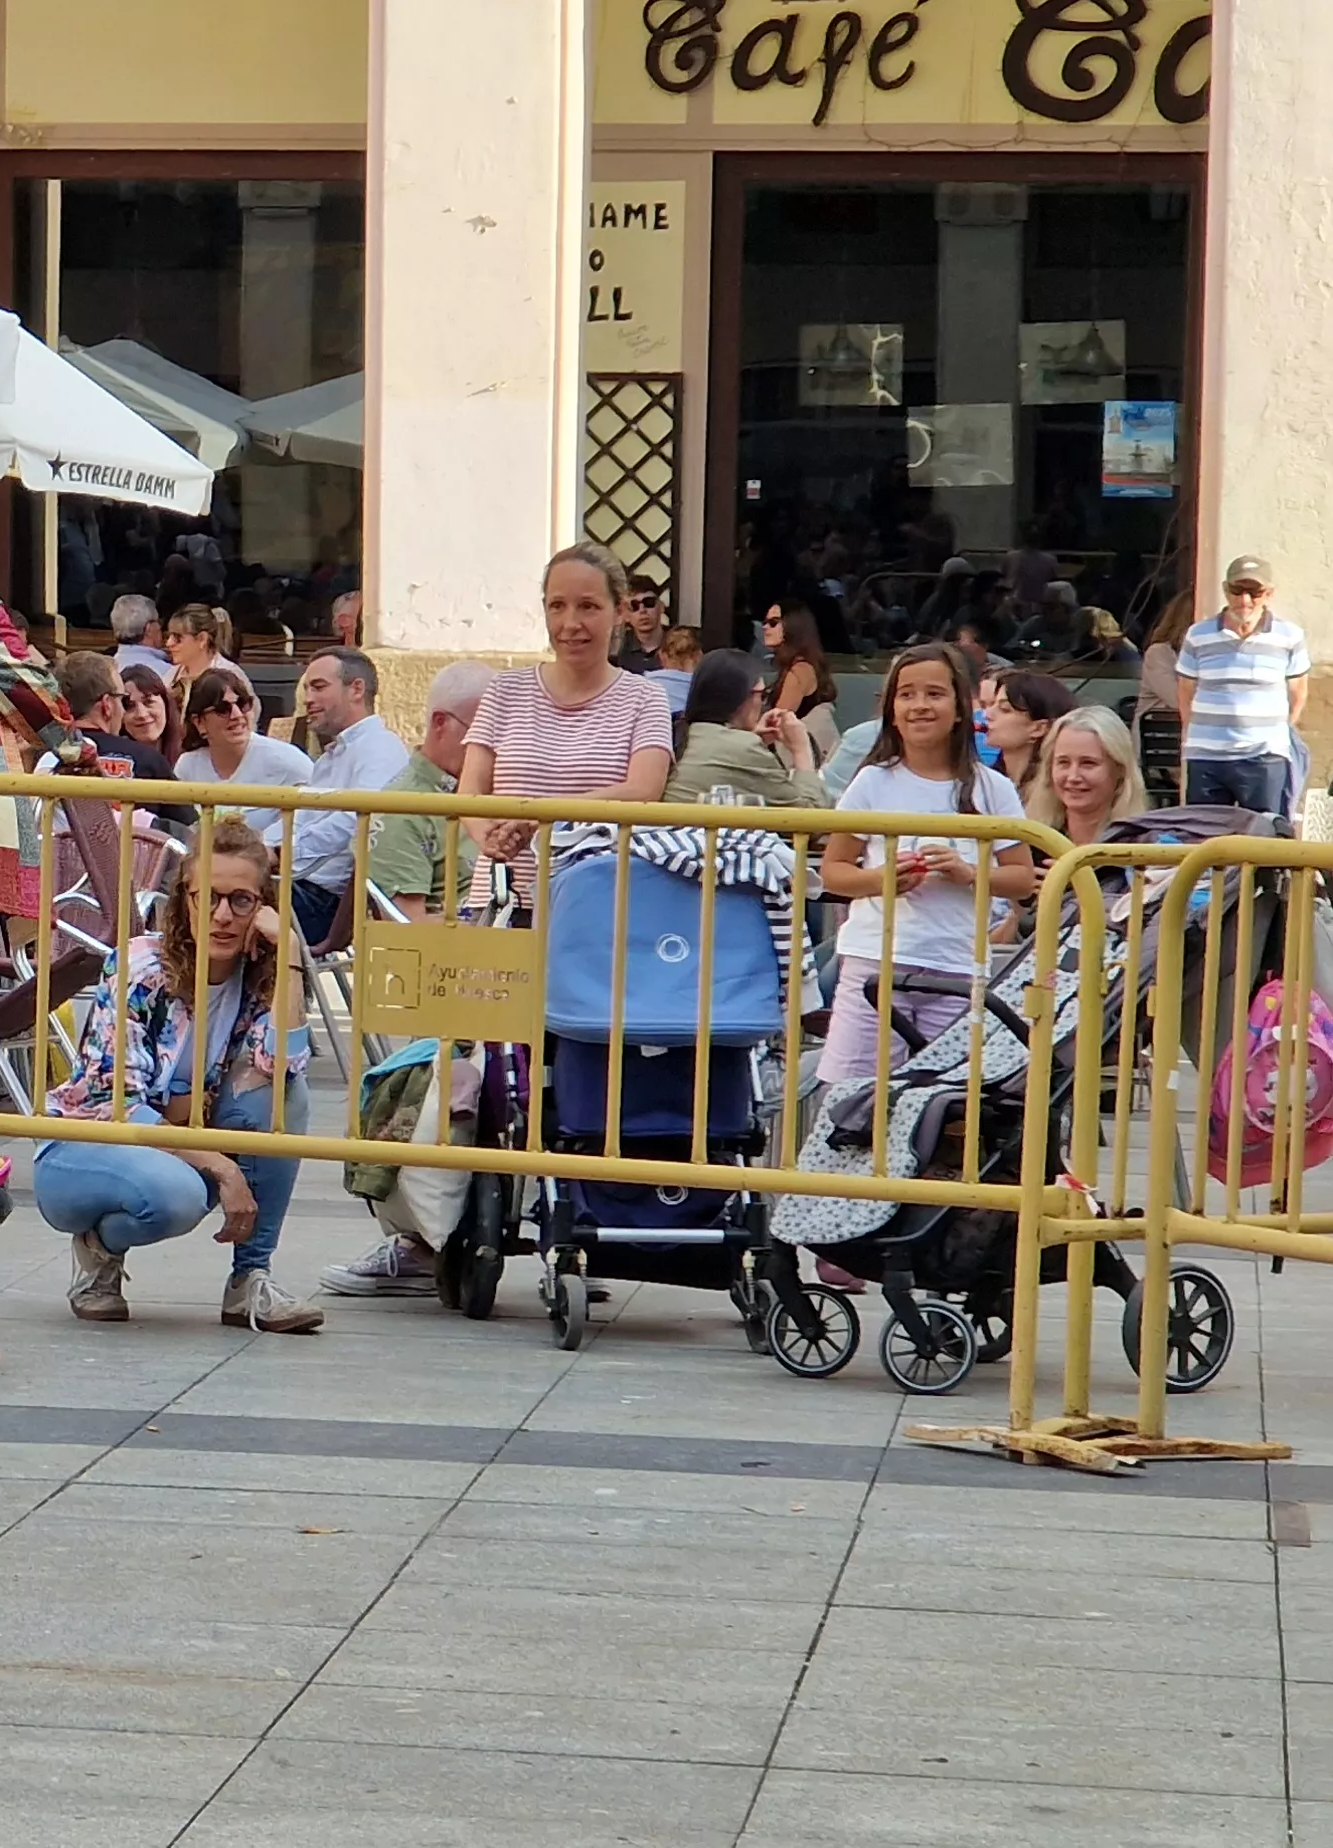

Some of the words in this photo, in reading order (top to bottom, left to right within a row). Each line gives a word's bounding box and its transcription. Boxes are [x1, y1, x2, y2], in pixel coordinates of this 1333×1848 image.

[643, 0, 931, 127] Café
[69, 462, 132, 490] ESTRELLA
[135, 472, 176, 499] DAMM
